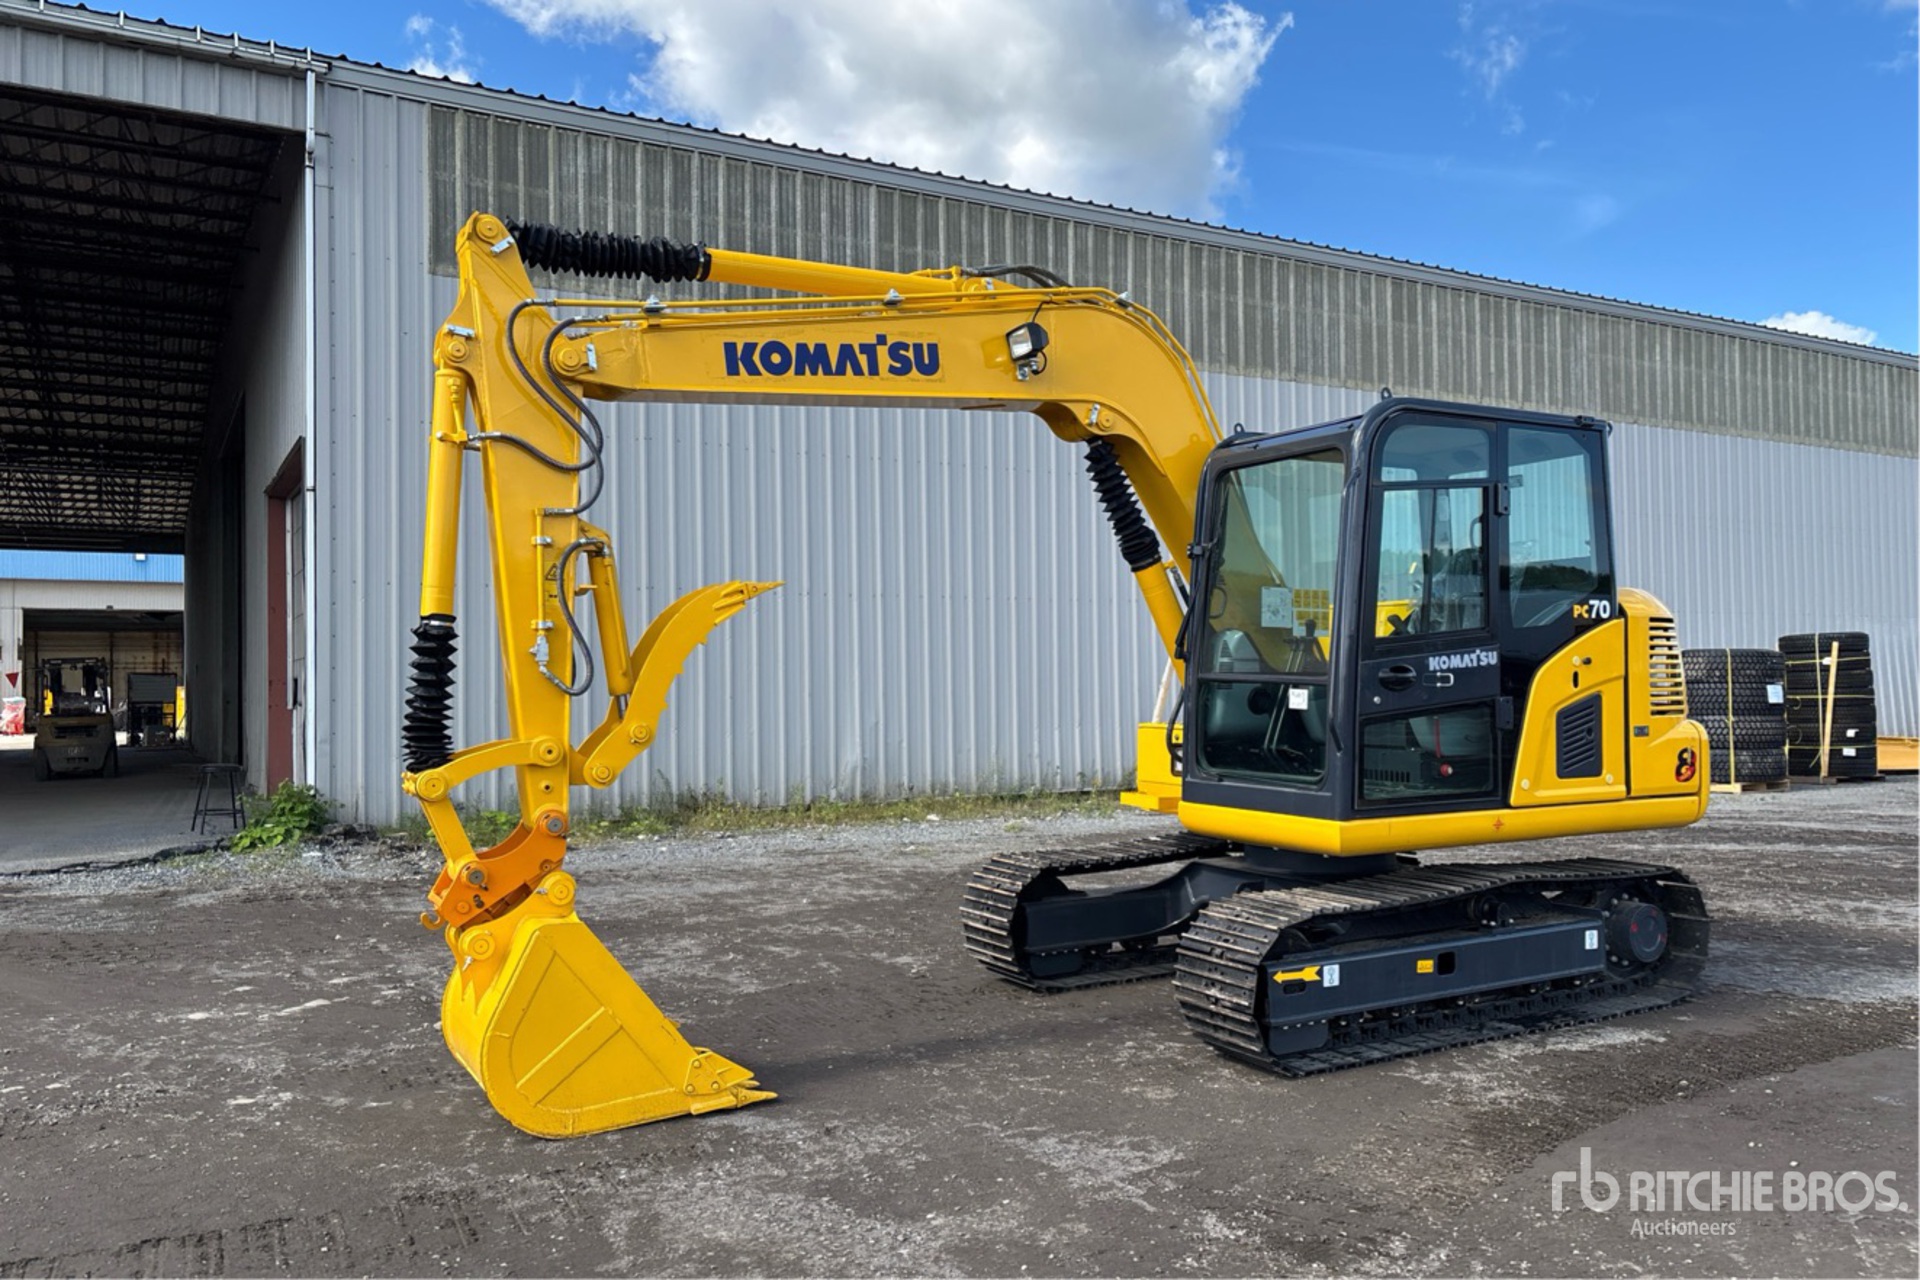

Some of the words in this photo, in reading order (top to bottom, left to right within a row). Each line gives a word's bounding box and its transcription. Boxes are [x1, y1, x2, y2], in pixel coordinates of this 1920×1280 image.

[723, 334, 940, 376] KOMATSU
[1572, 599, 1611, 619] PC70
[1428, 649, 1498, 671] KOMATSU
